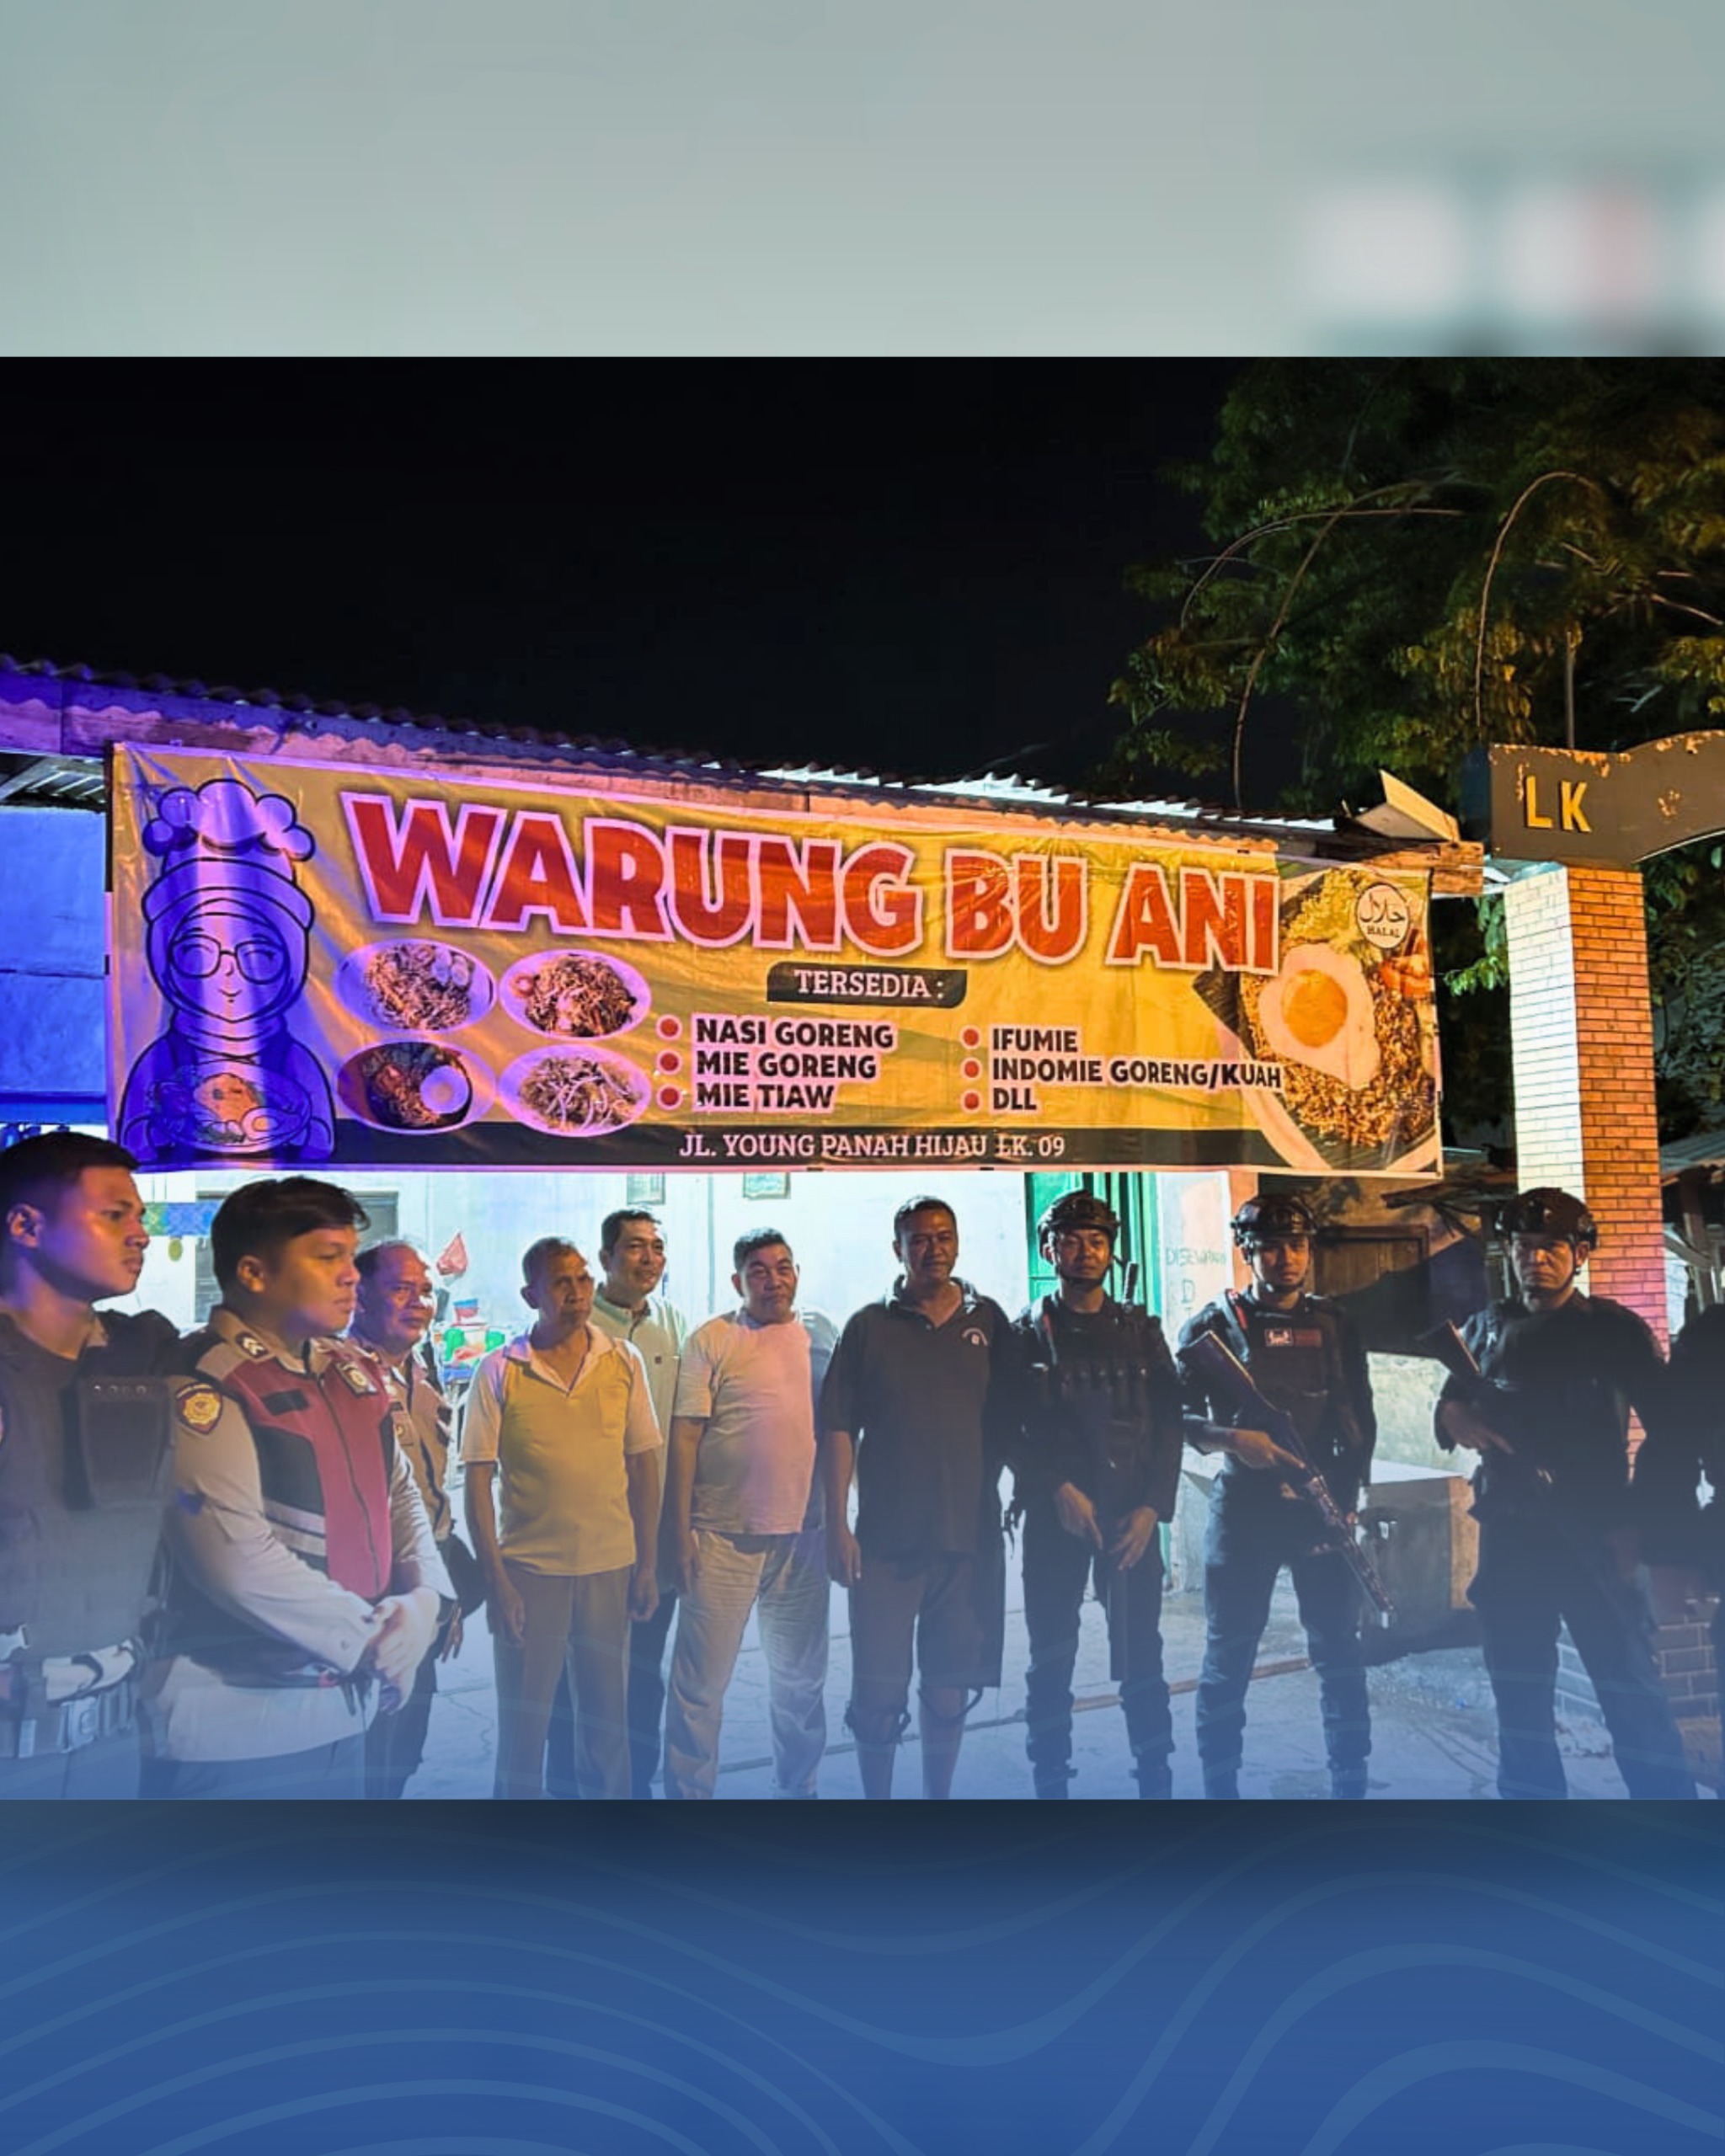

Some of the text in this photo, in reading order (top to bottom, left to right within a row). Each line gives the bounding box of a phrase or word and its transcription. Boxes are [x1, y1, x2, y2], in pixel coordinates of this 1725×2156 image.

[340, 792, 1280, 976] WARUNG BU ANI
[1367, 926, 1400, 938] HALAL
[697, 1018, 894, 1049] NASI GORENG
[993, 1028, 1078, 1053] IFUMIE
[697, 1050, 877, 1079] MIE GORENG
[993, 1058, 1281, 1090] INDOMIE GORENG/KUAH
[697, 1082, 835, 1108] MIE TIAW
[993, 1087, 1038, 1111] DLL
[679, 1134, 717, 1157] JL.
[723, 1134, 816, 1157] YOUNG
[820, 1134, 909, 1157] PANAH
[914, 1134, 986, 1157] HIJAU
[1038, 1135, 1066, 1157] 09
